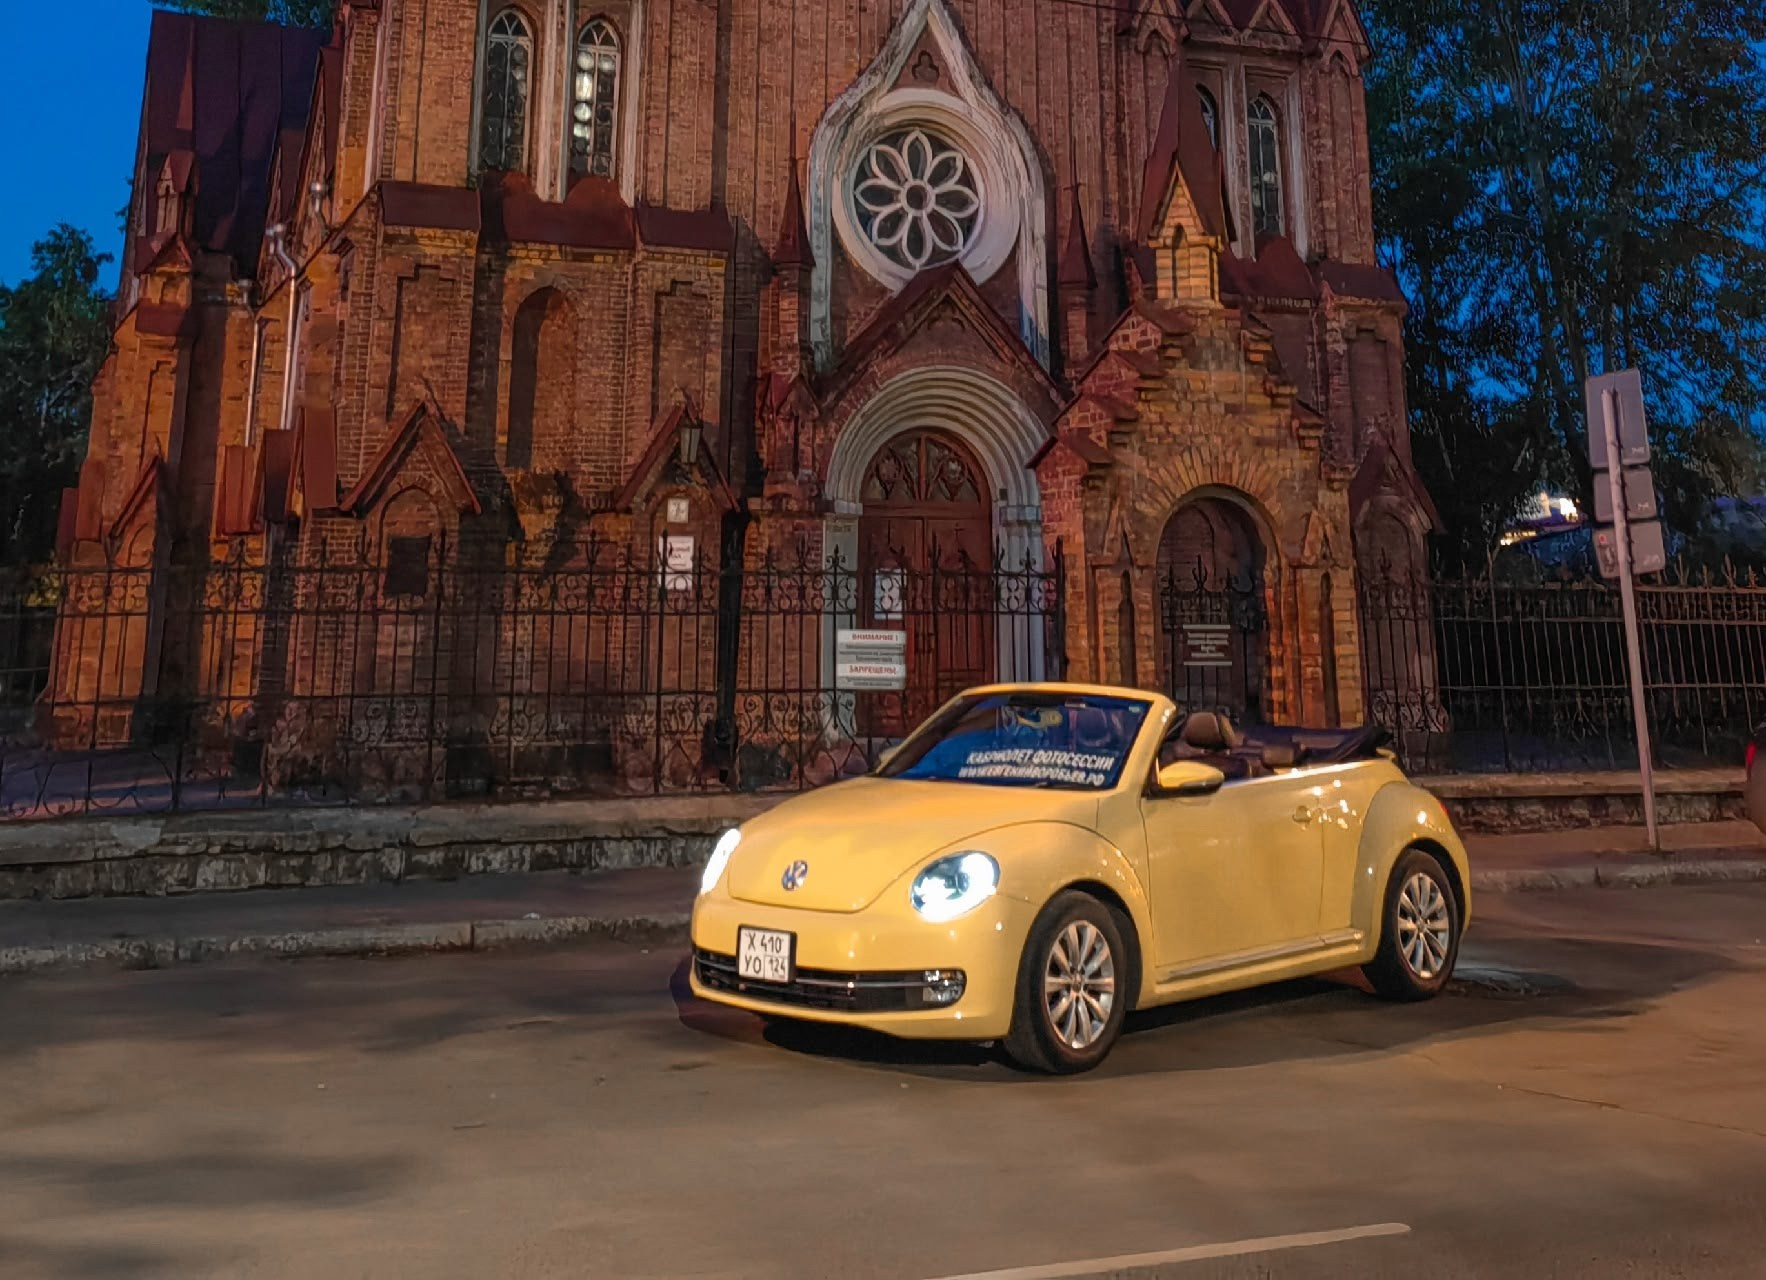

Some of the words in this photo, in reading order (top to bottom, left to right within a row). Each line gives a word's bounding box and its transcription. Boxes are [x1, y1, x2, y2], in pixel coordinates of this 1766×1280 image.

[967, 749, 1032, 765] КАБРИОЛЕТ
[1032, 749, 1115, 770] ФОТОСЕССИИ
[760, 934, 782, 954] 410
